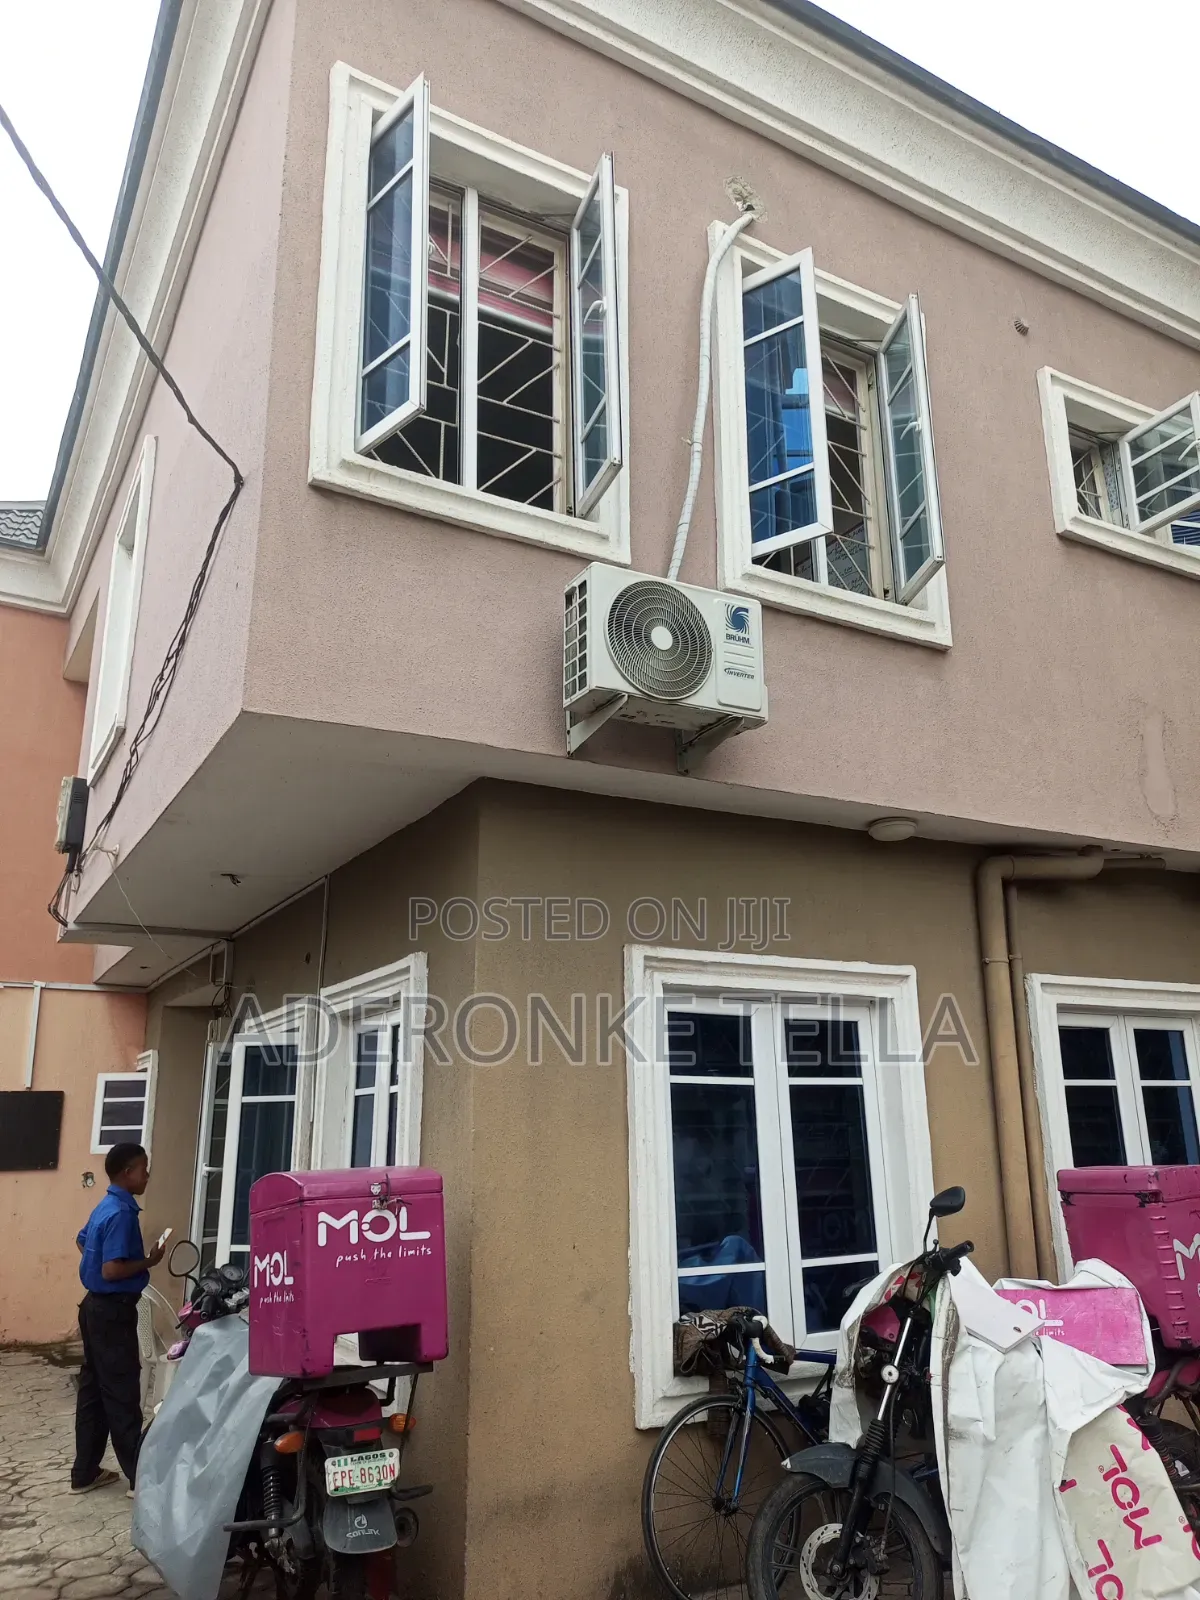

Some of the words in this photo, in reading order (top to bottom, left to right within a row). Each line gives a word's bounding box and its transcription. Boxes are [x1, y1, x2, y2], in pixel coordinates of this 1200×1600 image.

[317, 1206, 431, 1247] MOL
[254, 1249, 294, 1289] MOL
[336, 1248, 366, 1268] push
[373, 1247, 392, 1260] the
[398, 1244, 432, 1258] limits
[350, 1452, 387, 1463] LAGOS
[1102, 1444, 1163, 1550] MOL
